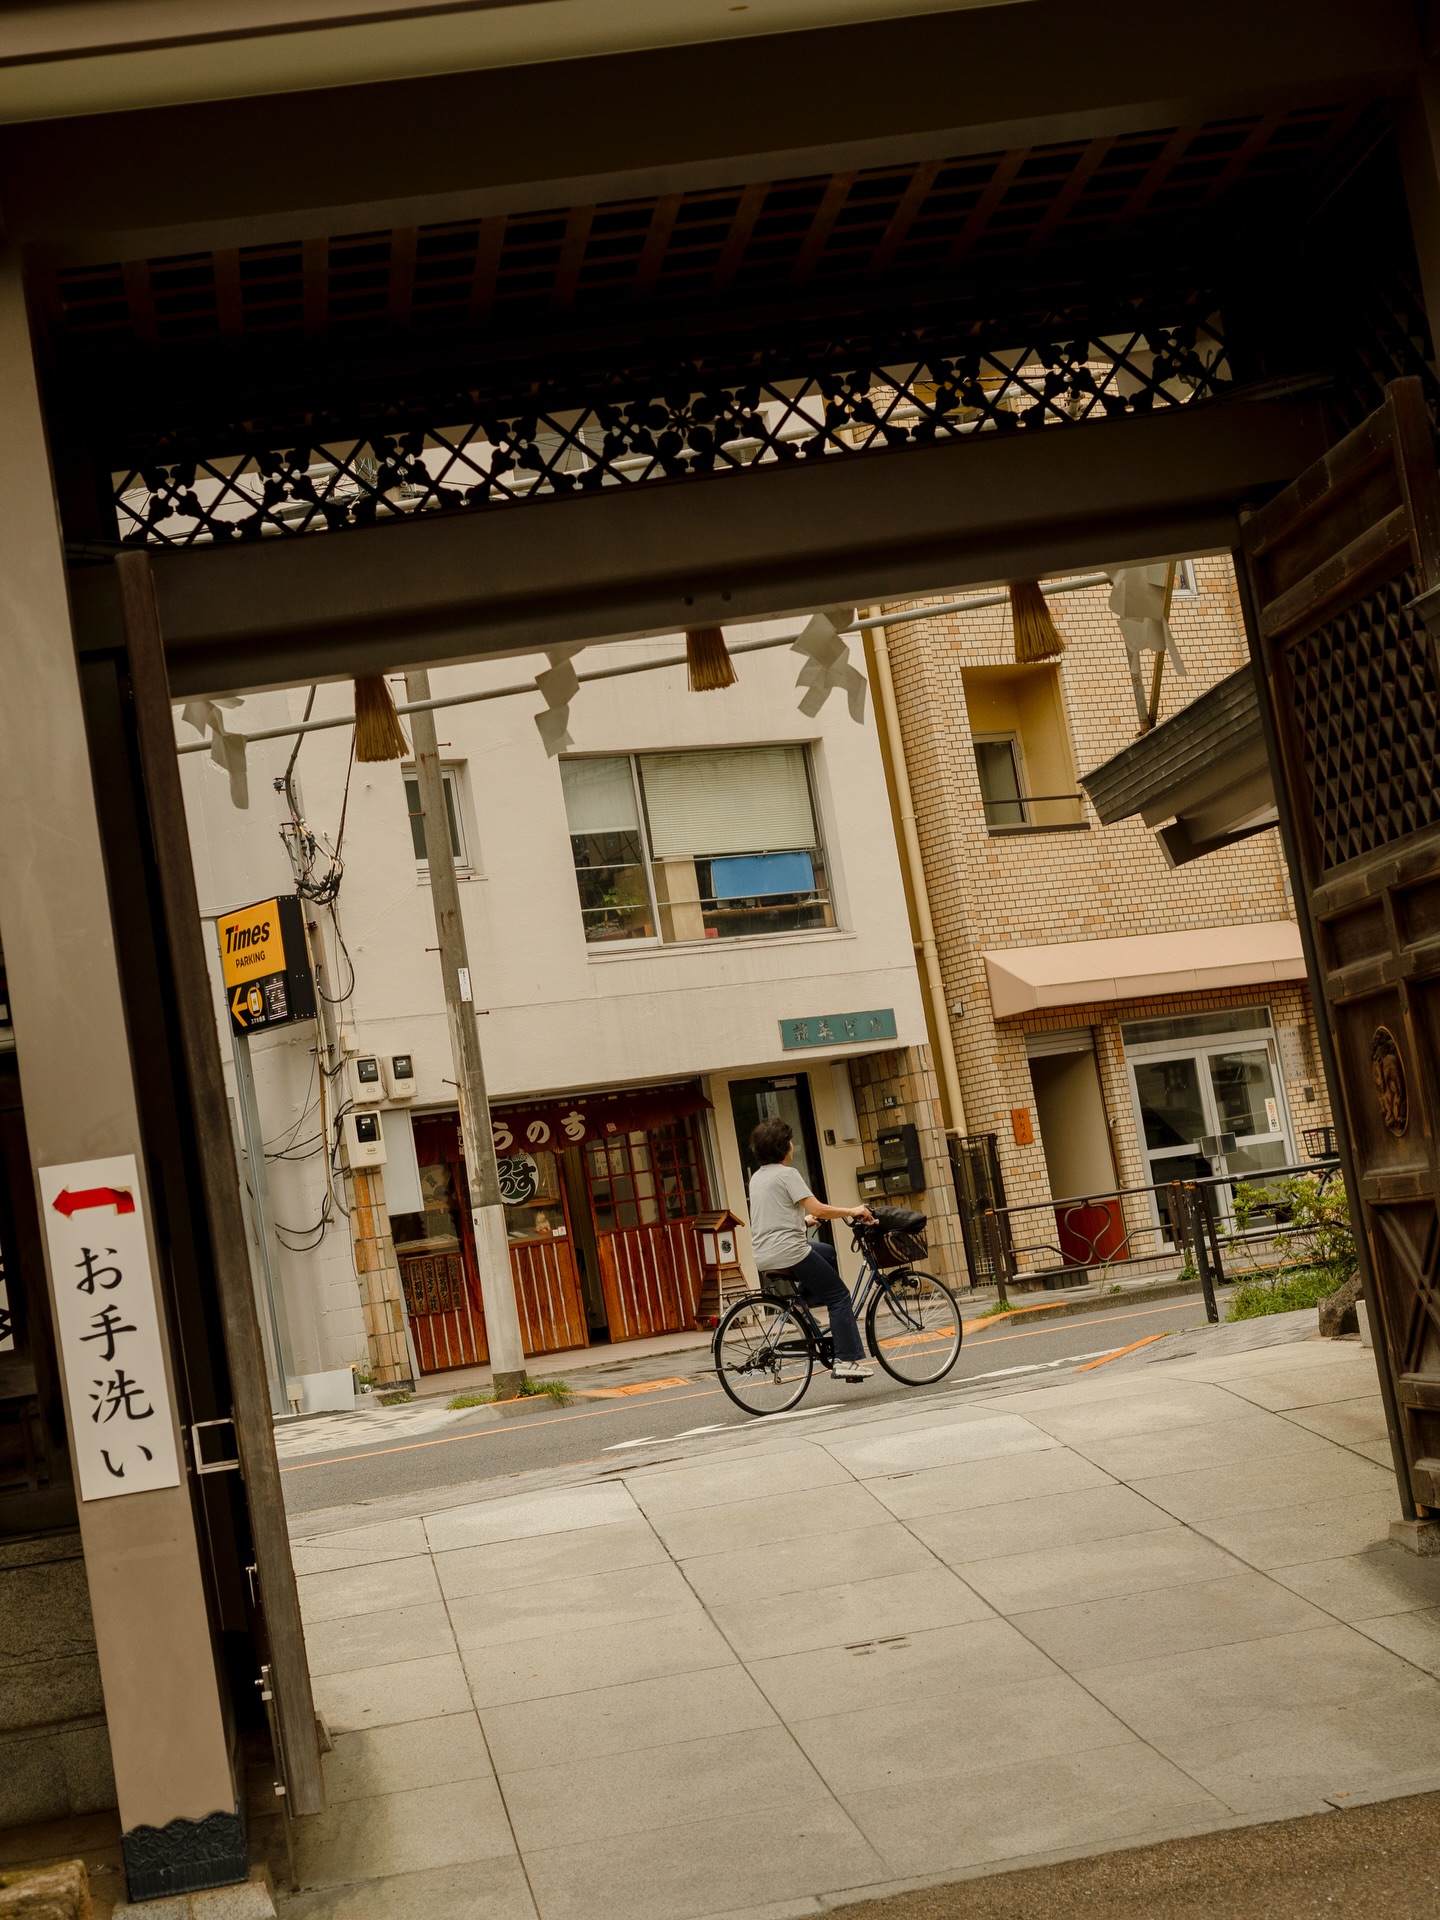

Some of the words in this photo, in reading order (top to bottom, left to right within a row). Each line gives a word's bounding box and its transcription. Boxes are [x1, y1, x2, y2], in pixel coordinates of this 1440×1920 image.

[225, 921, 270, 954] Times
[235, 950, 266, 969] PARKING
[74, 1247, 155, 1478] お手洗い
